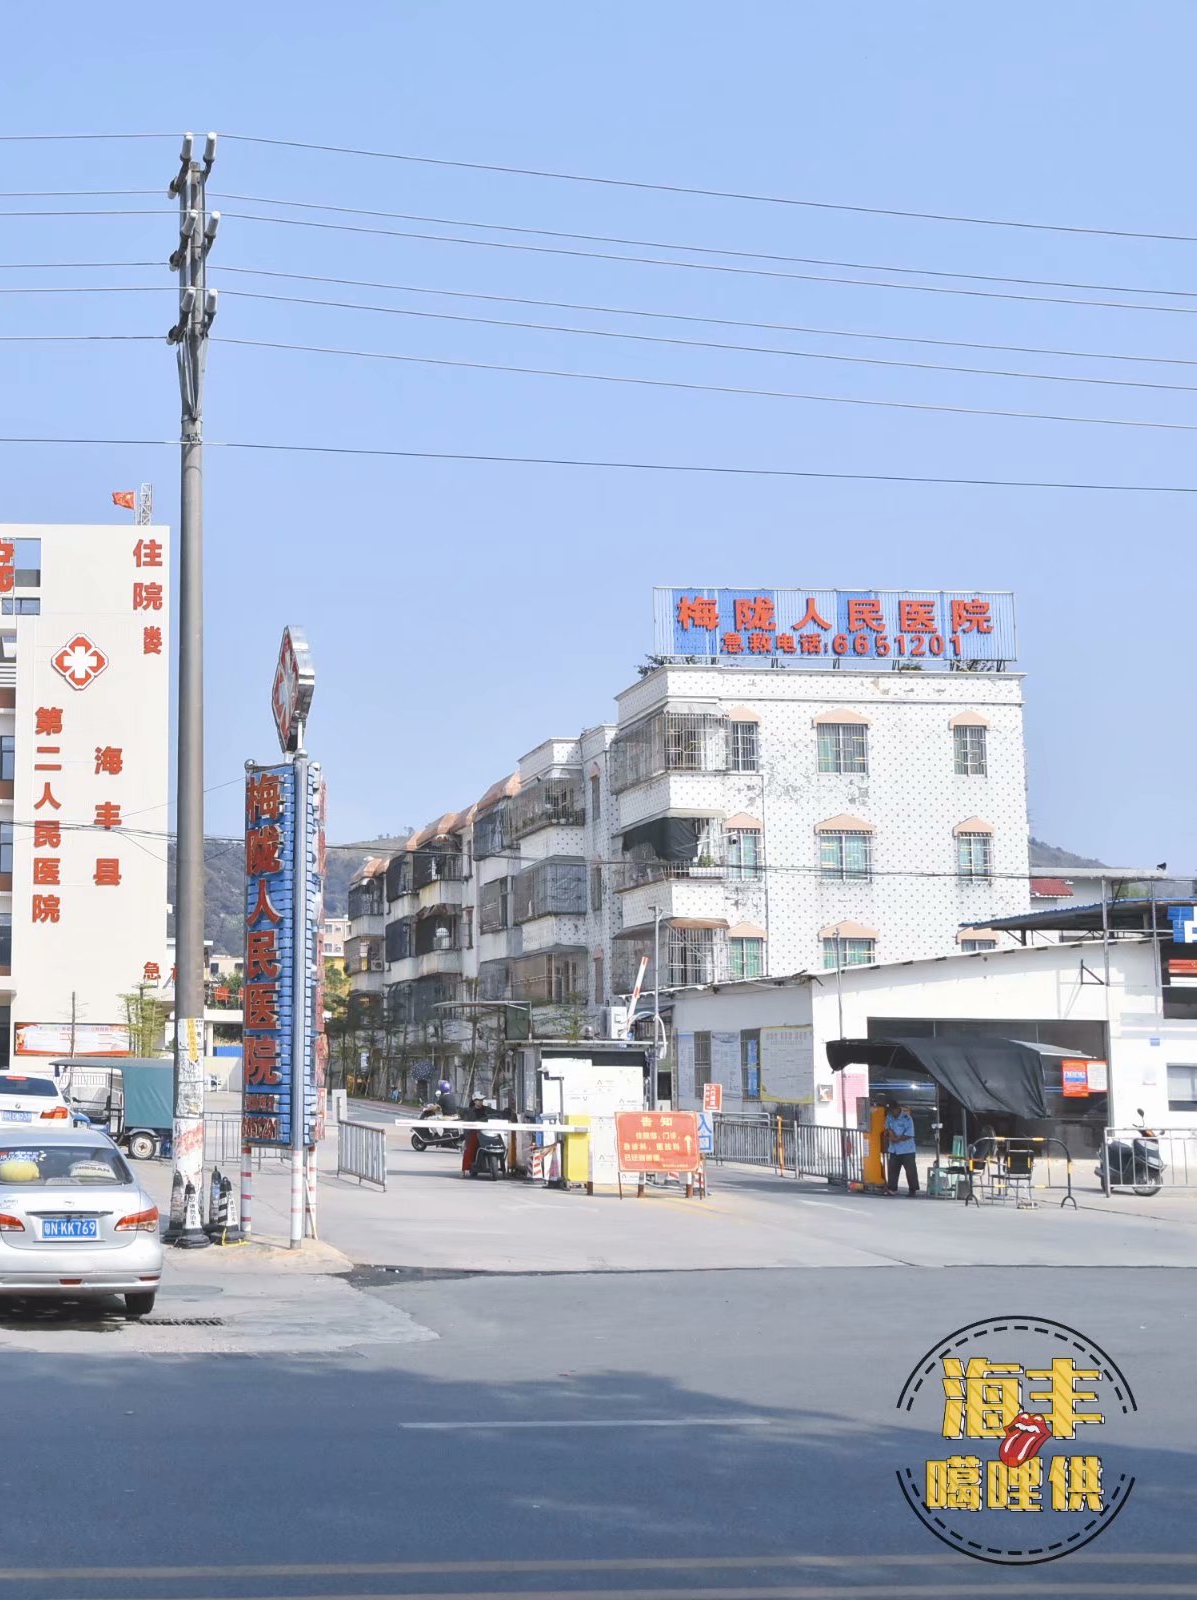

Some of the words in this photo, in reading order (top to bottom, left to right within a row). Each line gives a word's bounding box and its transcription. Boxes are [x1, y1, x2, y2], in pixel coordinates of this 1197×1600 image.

[677, 595, 994, 634] 梅陇人民医院
[31, 707, 64, 923] 第二人民医院
[93, 746, 123, 887] 海丰县
[244, 773, 284, 1087] 梅陇人民医院
[640, 1116, 673, 1127] 告知
[698, 1114, 713, 1151] 入口
[74, 1165, 111, 1174] NISSAN
